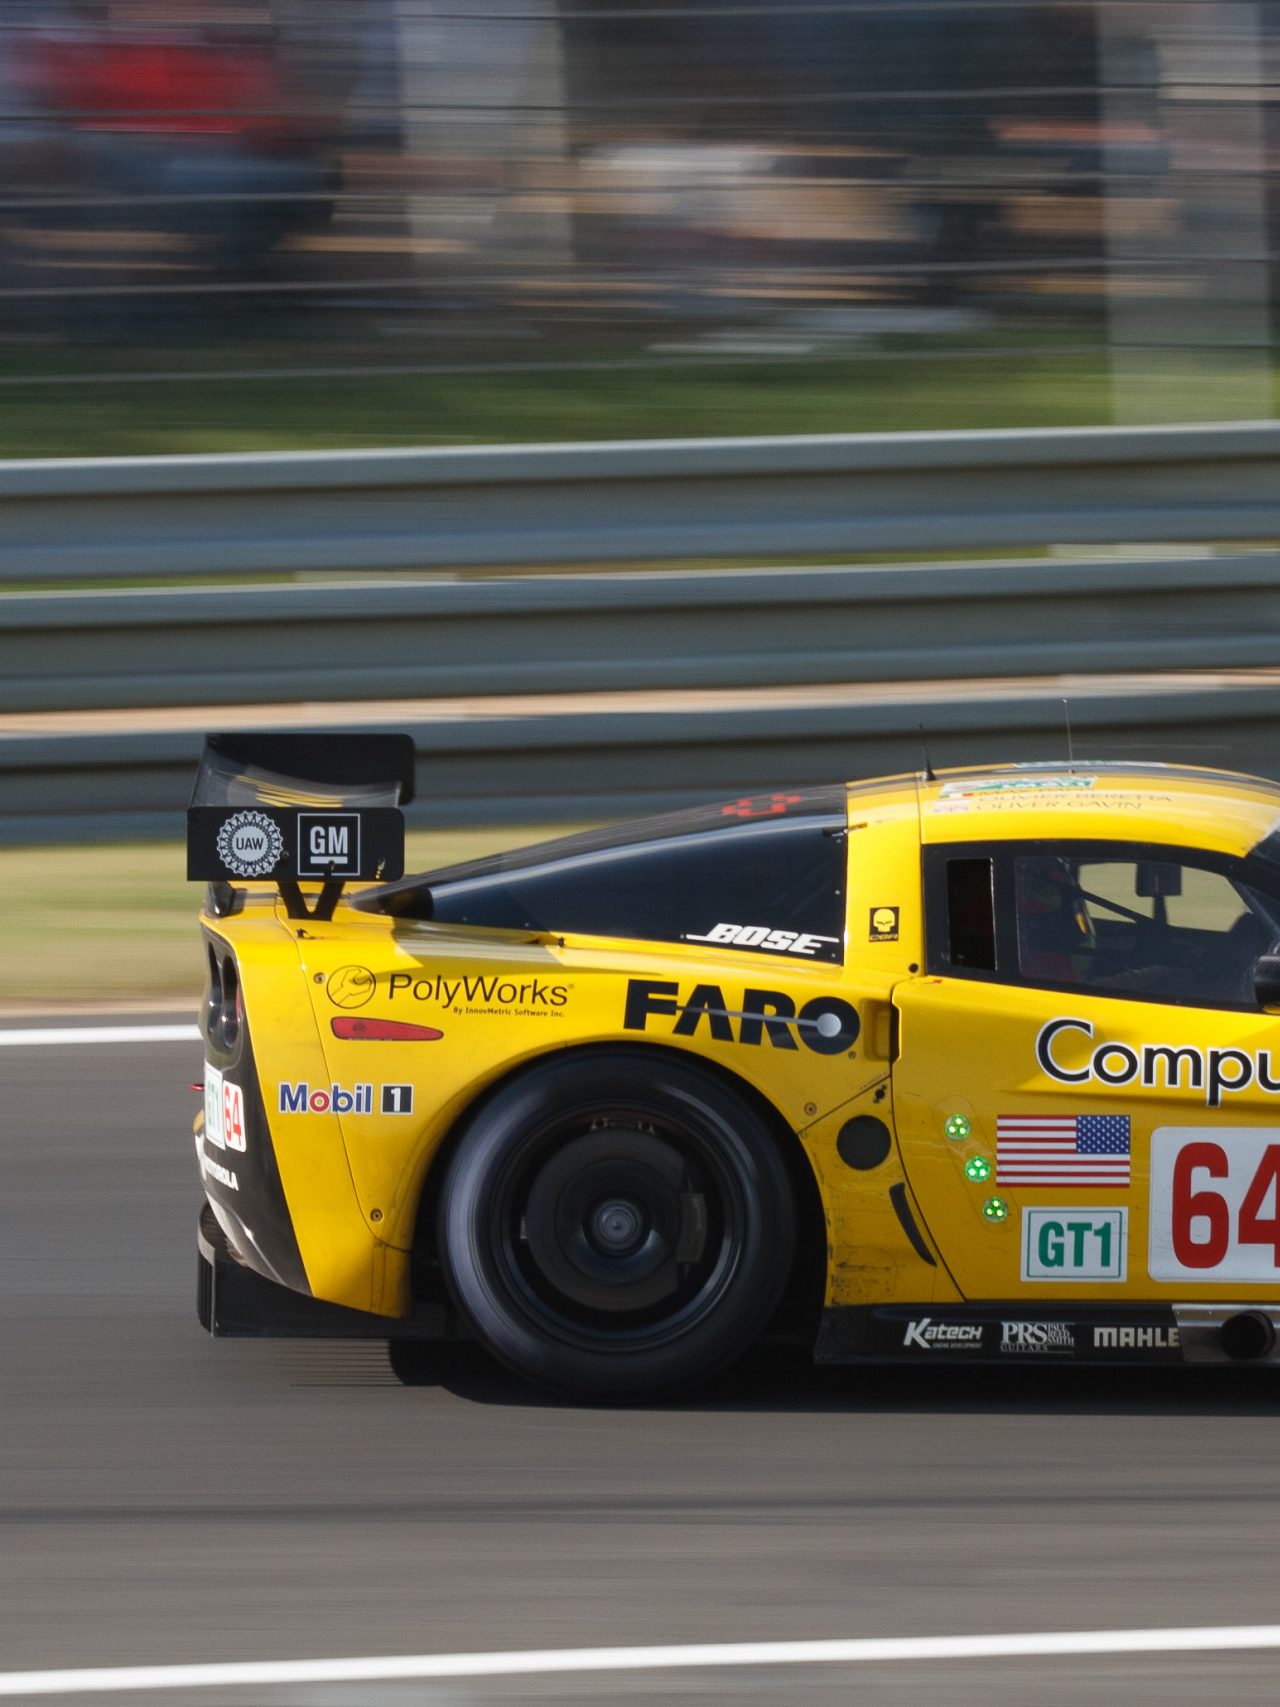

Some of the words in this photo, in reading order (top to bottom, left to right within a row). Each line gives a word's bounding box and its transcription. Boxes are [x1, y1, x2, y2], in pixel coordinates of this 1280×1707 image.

[235, 837, 264, 851] UAW
[309, 826, 348, 854] GM
[686, 923, 840, 955] BOSE
[388, 973, 568, 1009] PolyWorks
[453, 1006, 463, 1016] By
[465, 1007, 512, 1016] InnovMetric
[514, 1008, 548, 1017] Software
[550, 1010, 566, 1018] Inc.
[623, 979, 861, 1056] FARO
[279, 1082, 373, 1114] Mobil
[224, 1085, 242, 1146] 64
[1038, 1221, 1112, 1268] GT1
[1001, 1321, 1049, 1345] PRS
[1093, 1326, 1181, 1348] MAHLE
